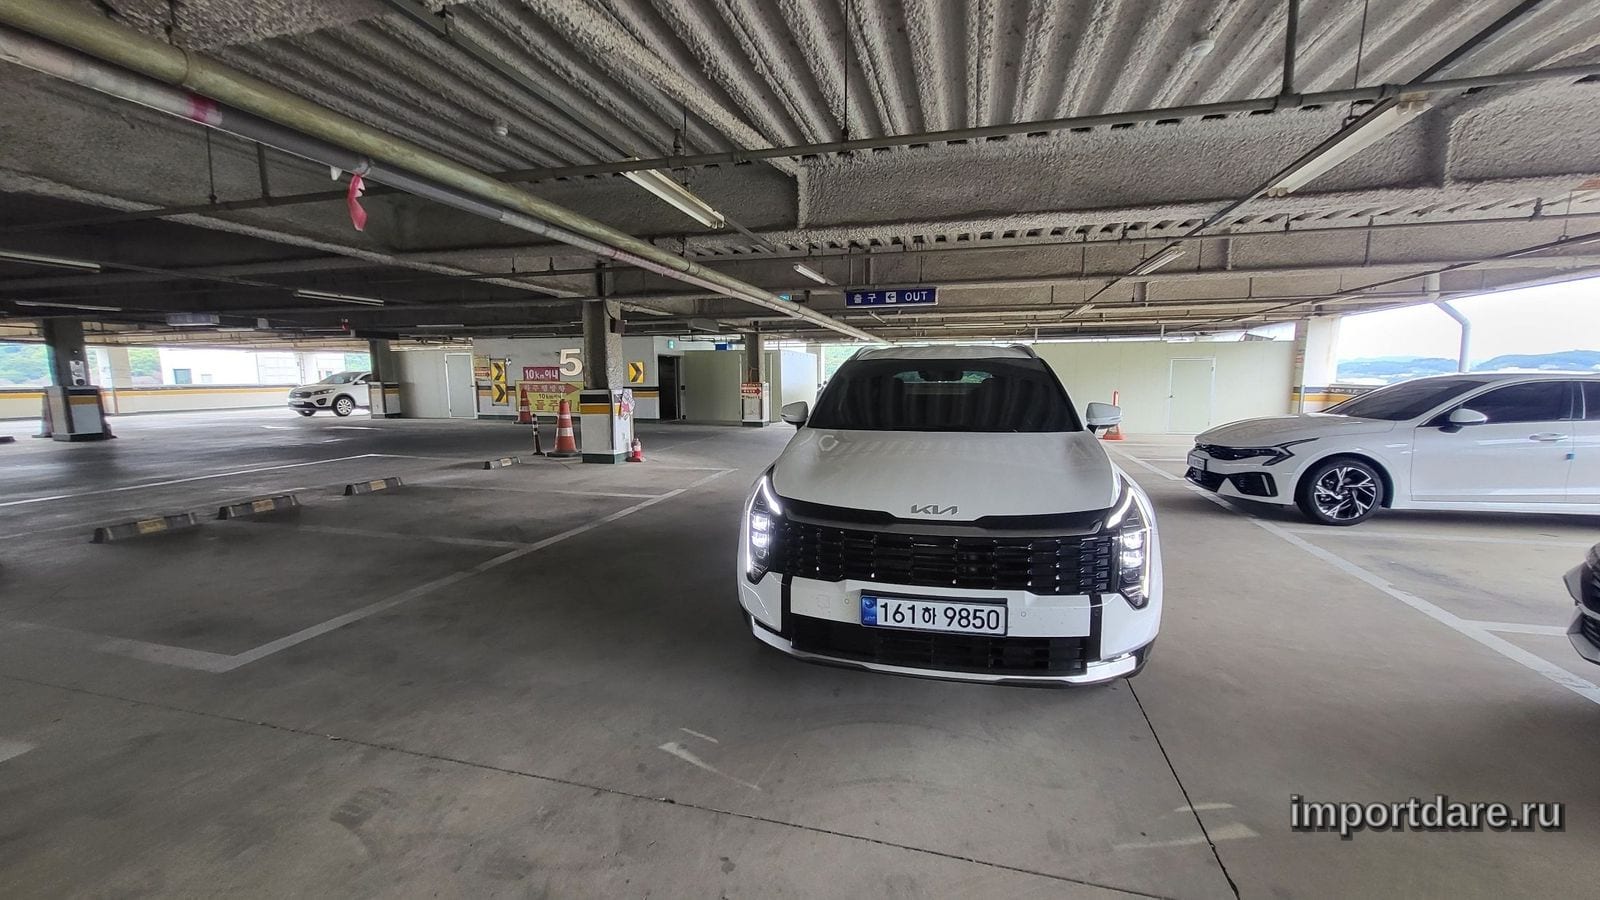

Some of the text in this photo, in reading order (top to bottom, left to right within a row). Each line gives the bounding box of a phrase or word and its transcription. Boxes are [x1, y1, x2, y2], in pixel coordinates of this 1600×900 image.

[904, 291, 928, 302] OUT
[560, 348, 583, 376] 5
[911, 504, 958, 515] KIA
[880, 602, 1000, 630] 161하 9850
